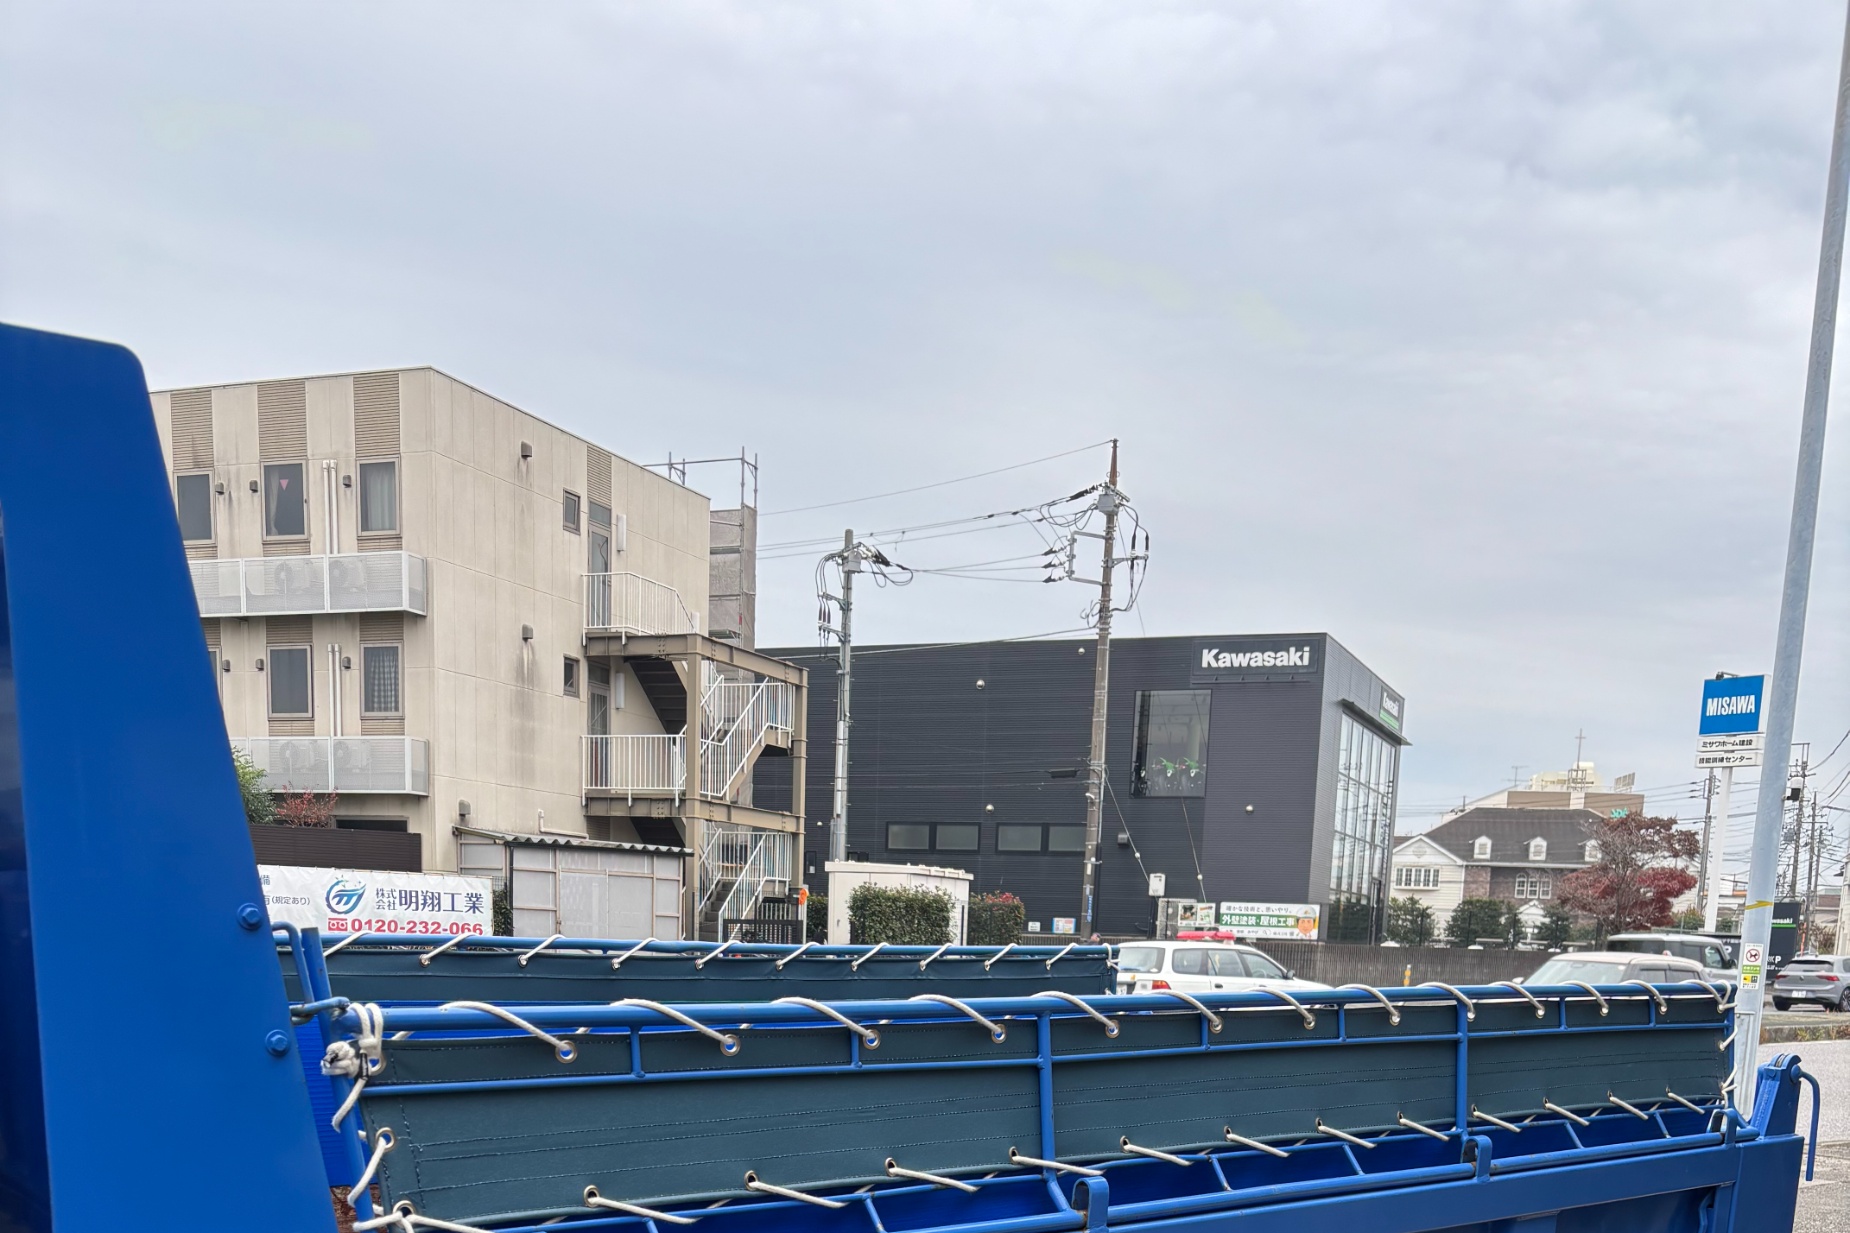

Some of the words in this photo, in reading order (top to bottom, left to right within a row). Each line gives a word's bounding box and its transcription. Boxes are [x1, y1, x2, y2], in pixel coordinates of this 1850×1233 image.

[1201, 646, 1310, 668] Kawasaki
[1706, 694, 1756, 716] MISAWA
[375, 887, 397, 899] 株式
[399, 889, 484, 914] 明翔工業
[375, 899, 397, 911] 会社
[351, 918, 484, 936] 0120-232-066
